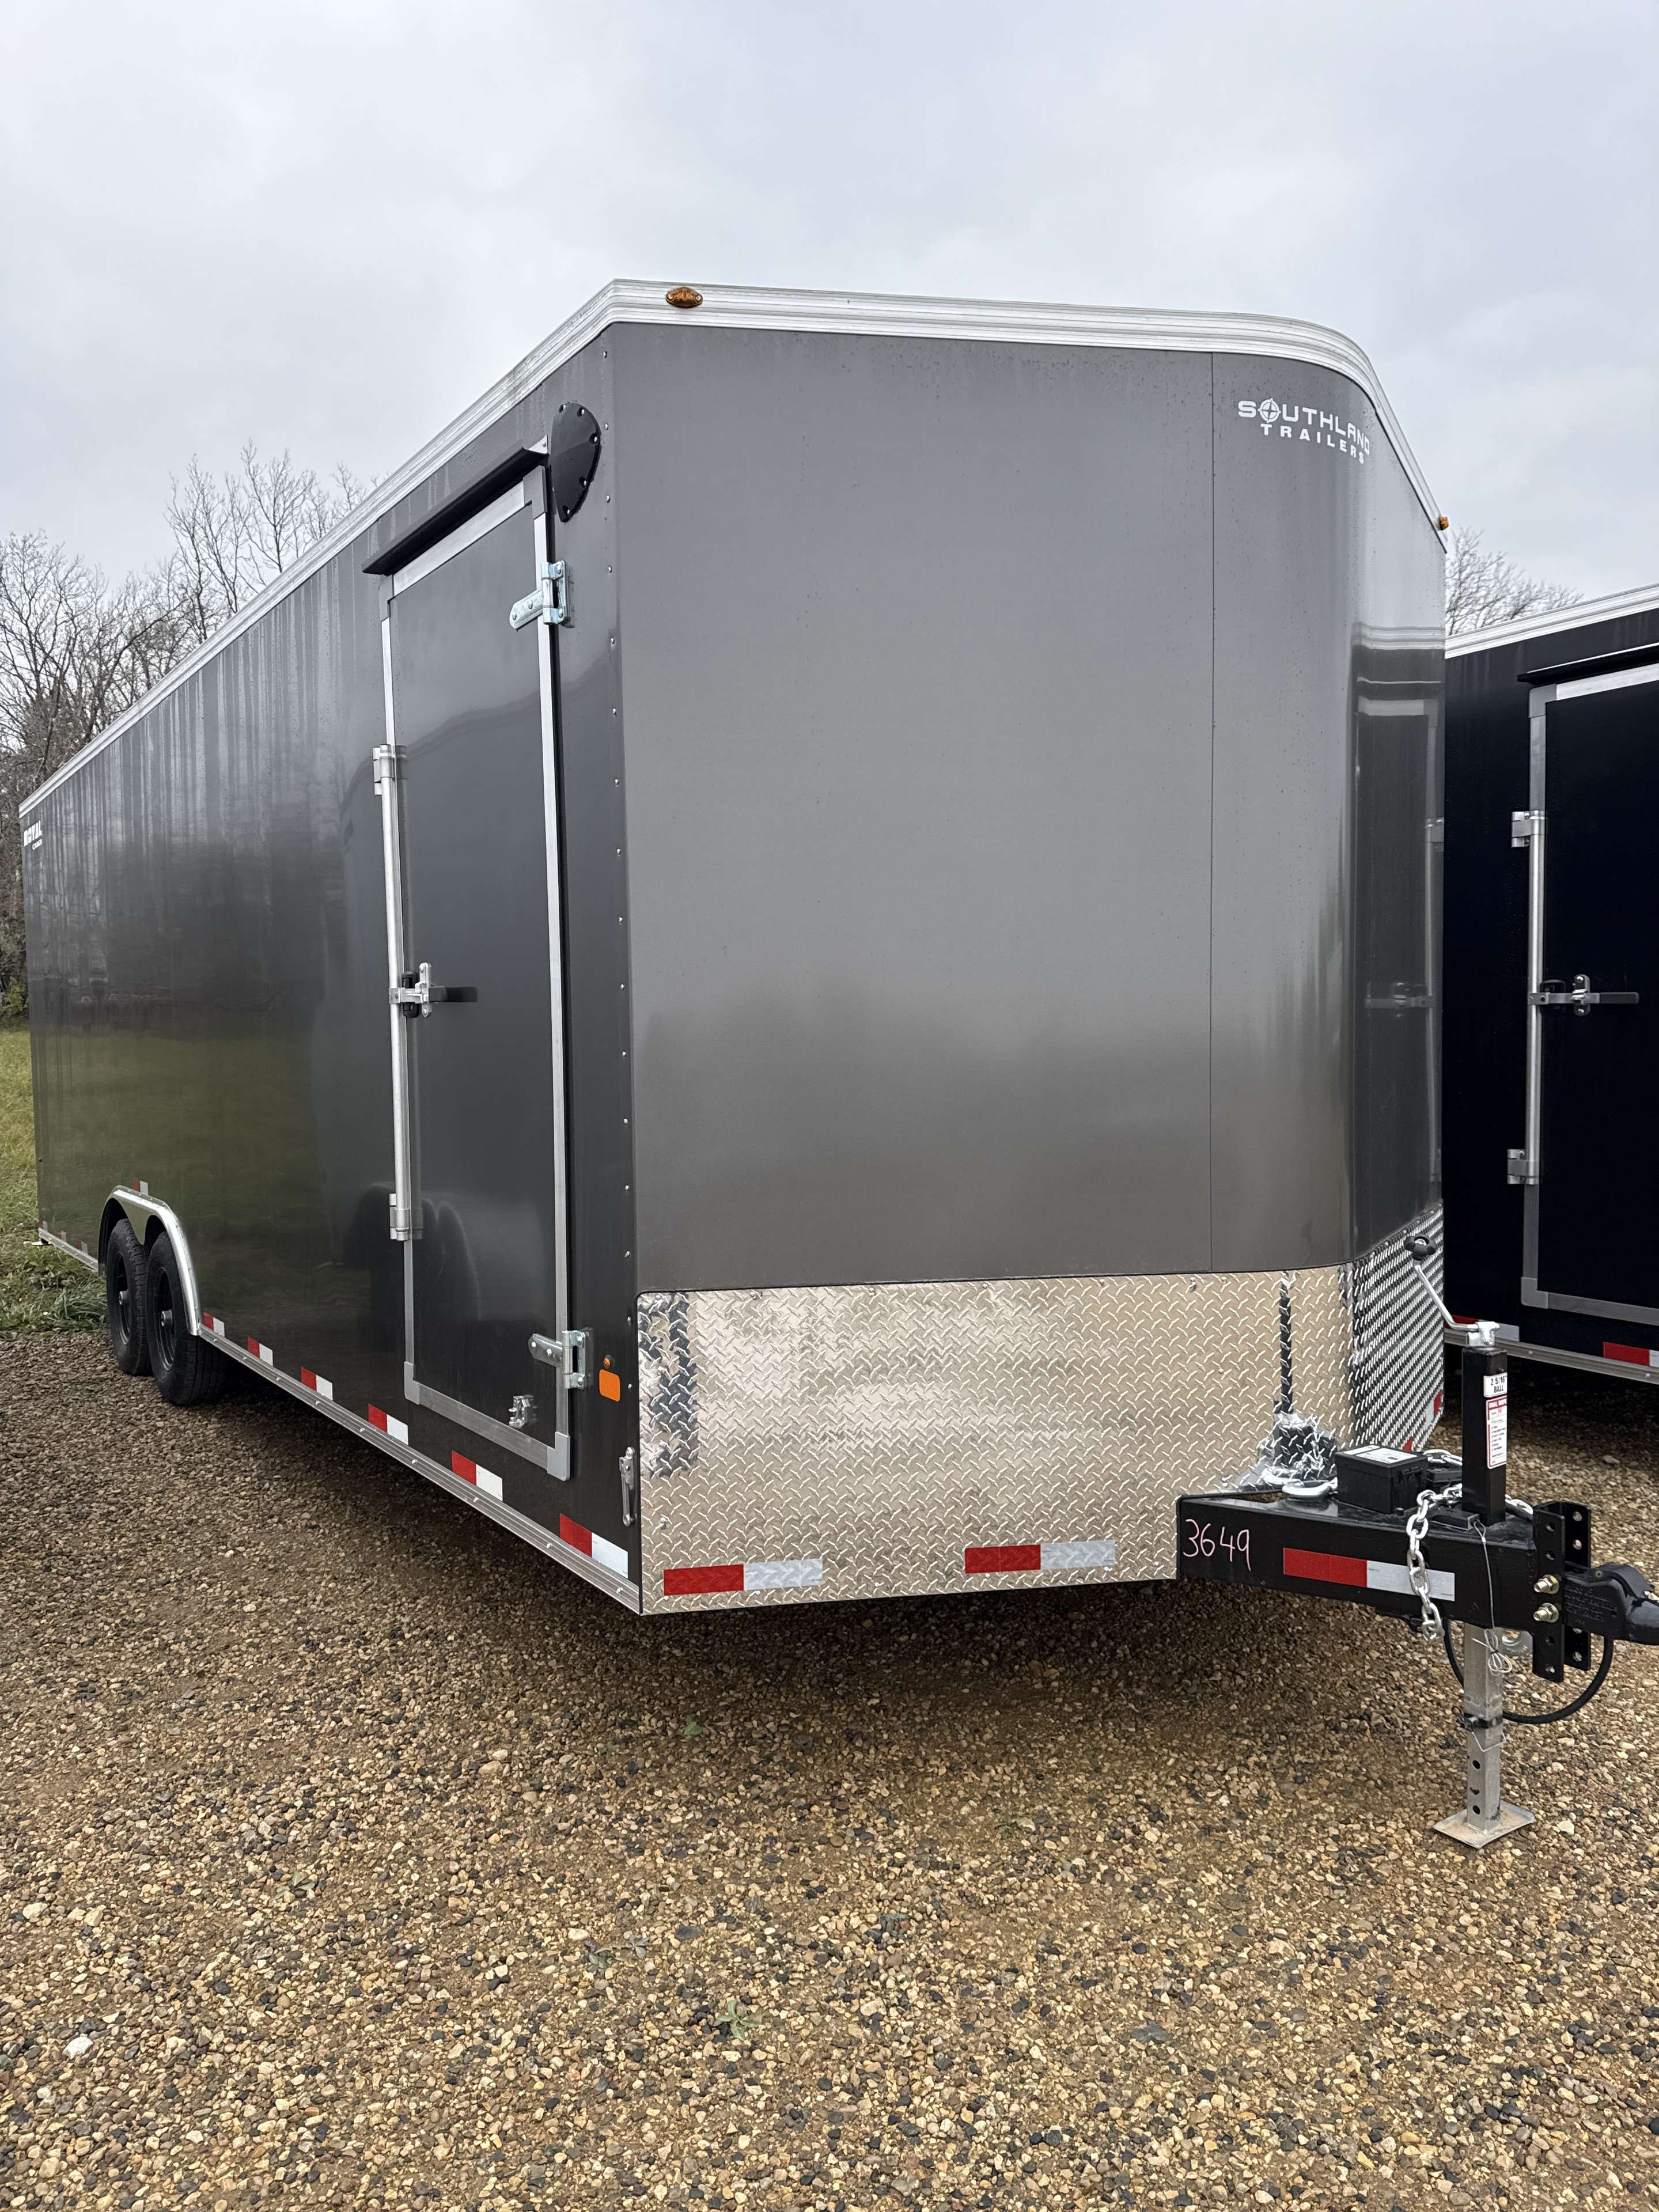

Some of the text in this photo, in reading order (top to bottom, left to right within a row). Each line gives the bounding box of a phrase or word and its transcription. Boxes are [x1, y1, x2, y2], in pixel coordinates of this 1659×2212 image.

[1238, 398, 1370, 455] SOUTHLAND
[1260, 423, 1364, 464] TRAILERS
[1490, 1378, 1494, 1386] 2
[1494, 1384, 1504, 1393] BALL
[1183, 1518, 1252, 1572] 3649
